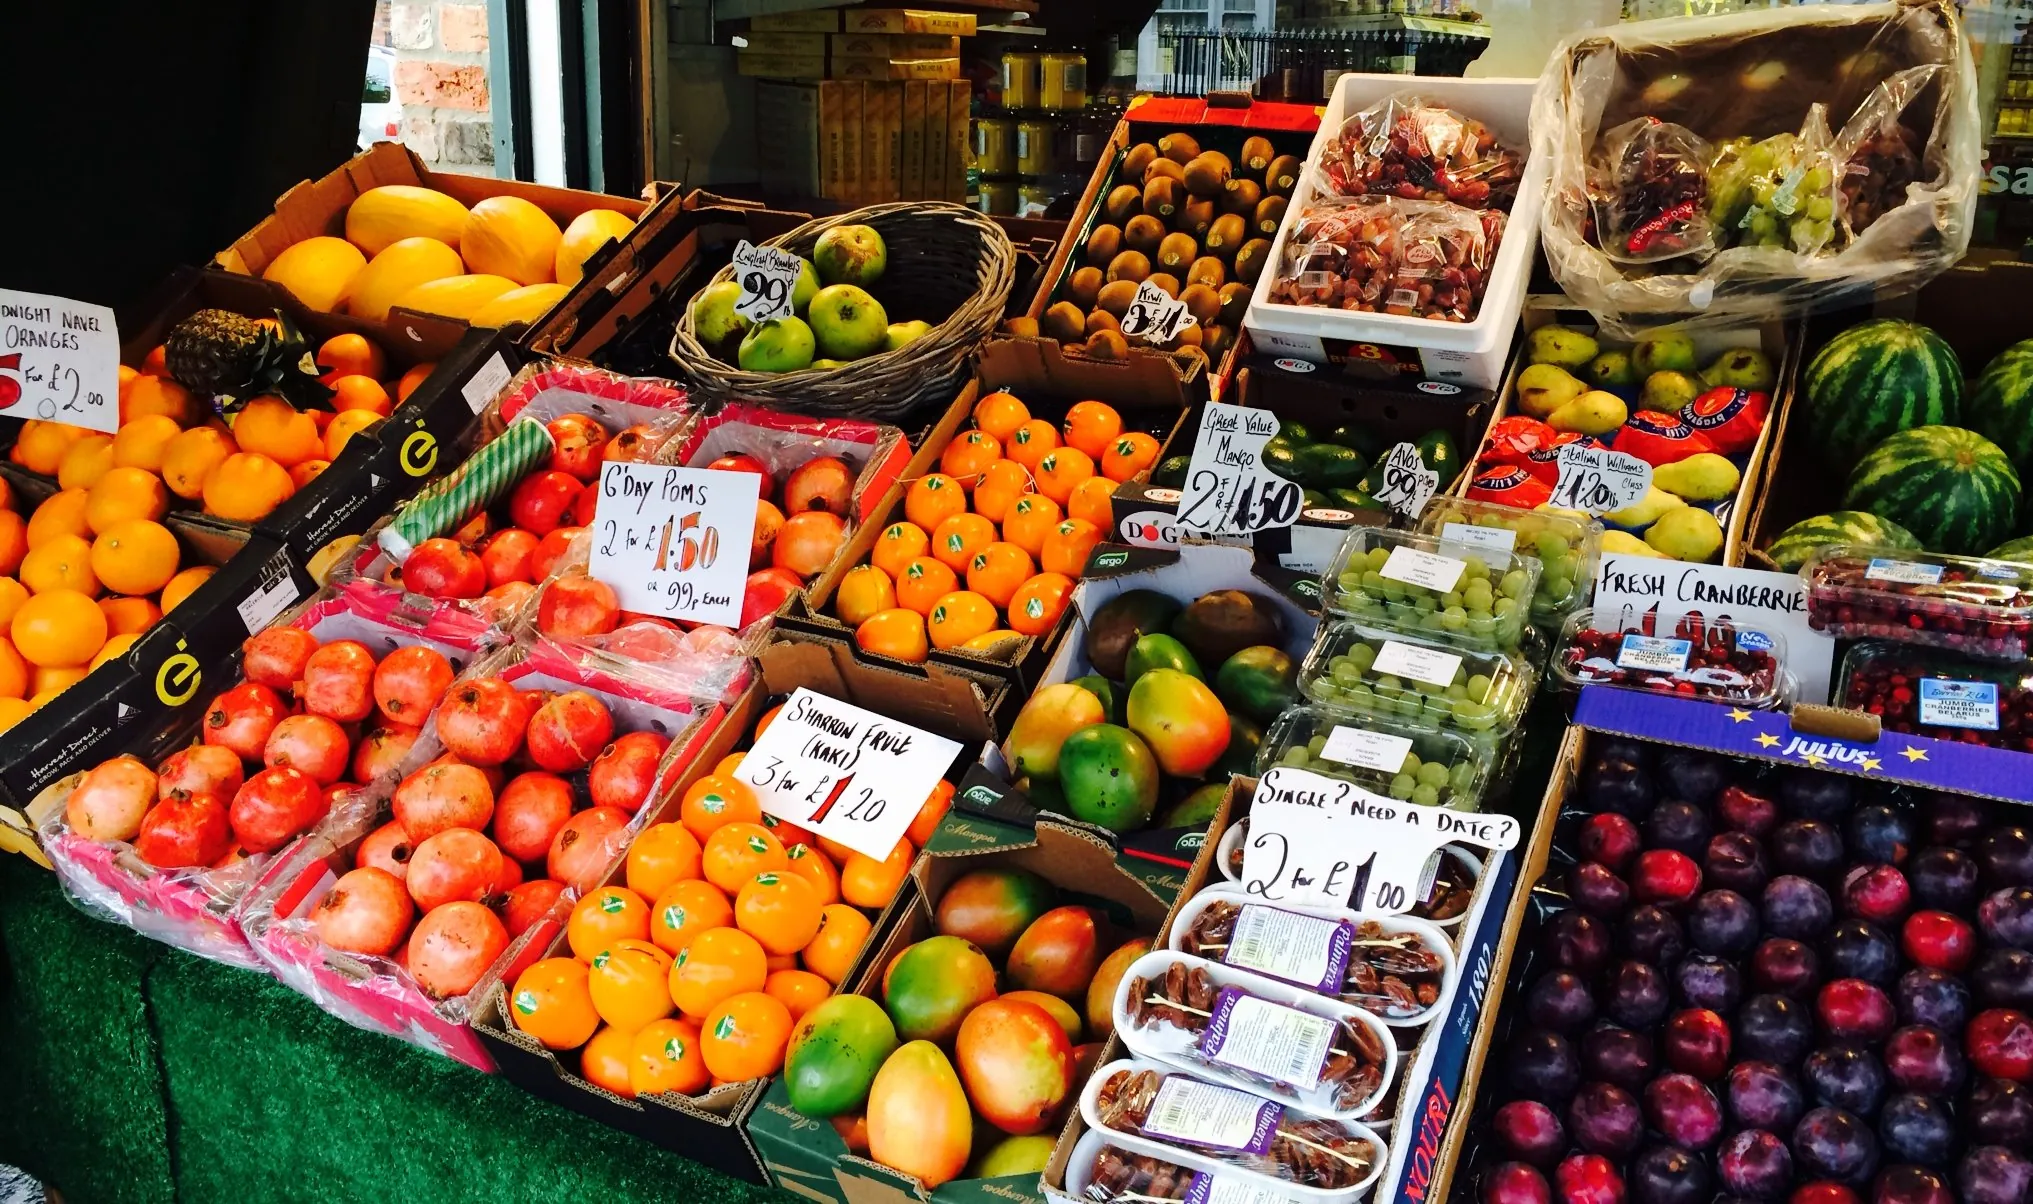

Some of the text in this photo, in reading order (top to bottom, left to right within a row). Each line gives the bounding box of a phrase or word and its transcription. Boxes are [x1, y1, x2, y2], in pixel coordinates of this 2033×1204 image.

[6, 324, 79, 350] ORANGES
[62, 311, 101, 332] NAVEL
[1123, 304, 1151, 333] 3
[1359, 344, 1382, 360] 3
[662, 469, 708, 506] POMS
[1176, 470, 1219, 529] 2
[601, 519, 617, 557] 2
[645, 511, 719, 573] £1.50
[1601, 559, 1665, 597] FRESH
[1924, 703, 1990, 714] CRANBERRIES
[1937, 709, 1981, 718] BELARUS
[1938, 699, 1975, 708] JUMBO
[26, 782, 39, 792] WE
[59, 755, 75, 769] PACK
[75, 745, 88, 757] AND
[88, 726, 112, 747] DELIVER
[29, 726, 98, 779] Harvest Direct
[751, 755, 784, 787] 3
[805, 771, 887, 824] £1.20
[1258, 770, 1513, 847] SINGLE? NEED A DATE?
[1246, 832, 1289, 901] 2
[1322, 851, 1406, 913] £1.00
[1325, 926, 1351, 990] Palmera
[1468, 942, 1495, 1008] 1892
[1205, 991, 1236, 1056] Palmera
[1252, 1101, 1281, 1151] Palmera
